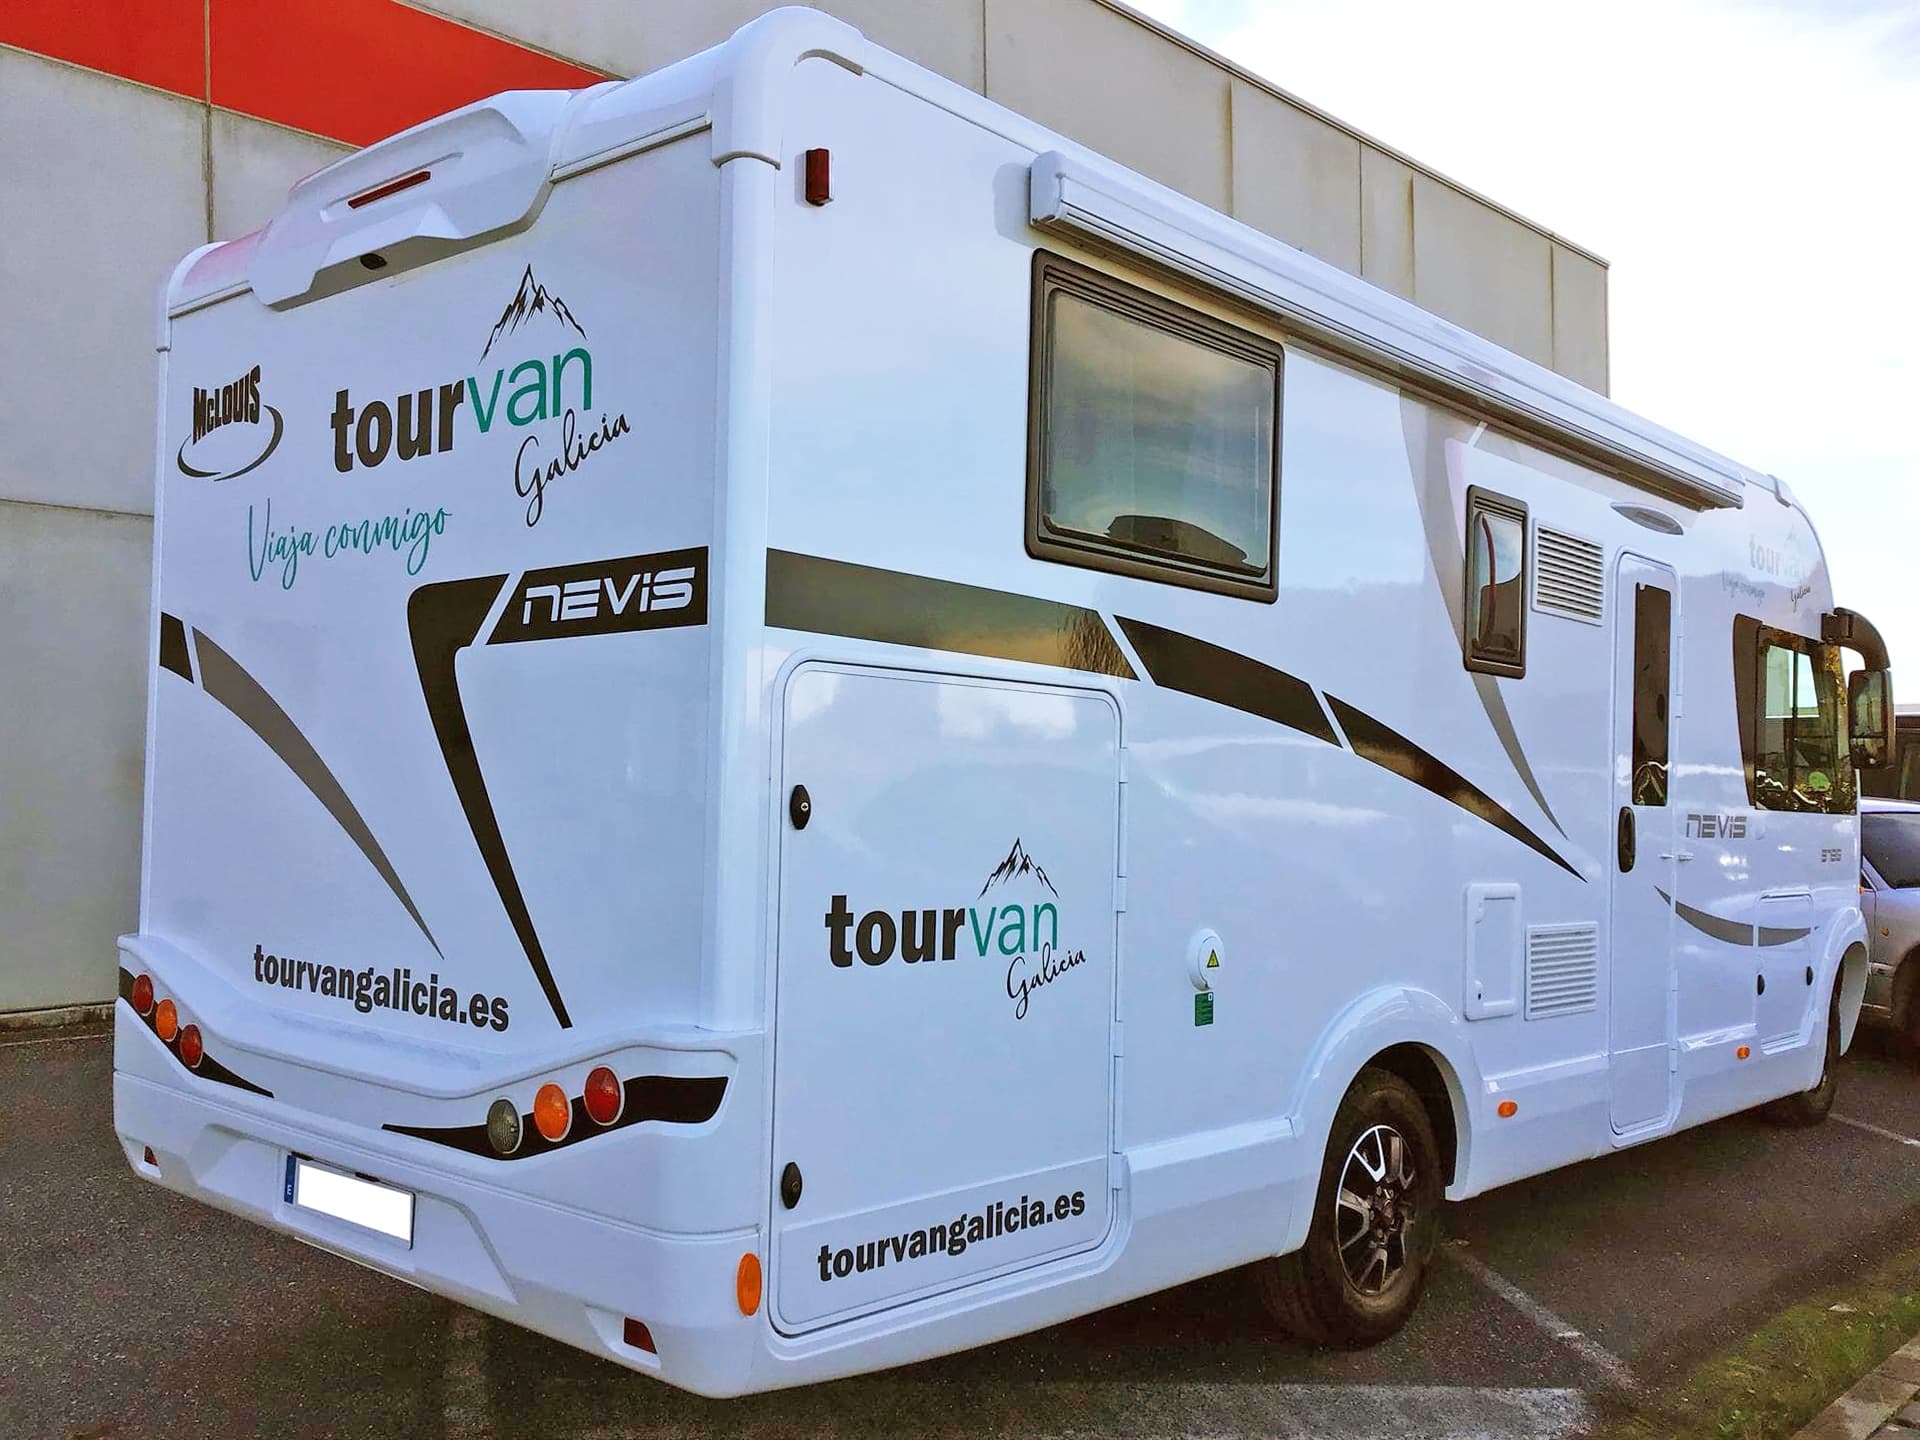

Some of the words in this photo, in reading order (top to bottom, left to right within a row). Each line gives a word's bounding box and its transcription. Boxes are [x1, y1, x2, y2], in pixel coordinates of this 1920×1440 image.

[331, 346, 593, 473] tourvan
[514, 408, 631, 527] Galicia
[248, 497, 320, 591] Viaja
[324, 506, 453, 576] conmigo
[824, 894, 1059, 968] tourvan
[253, 943, 511, 1032] tourvangalicia.es
[1006, 942, 1086, 1020] Galicia
[817, 1190, 1086, 1283] tourvangalicia.es
